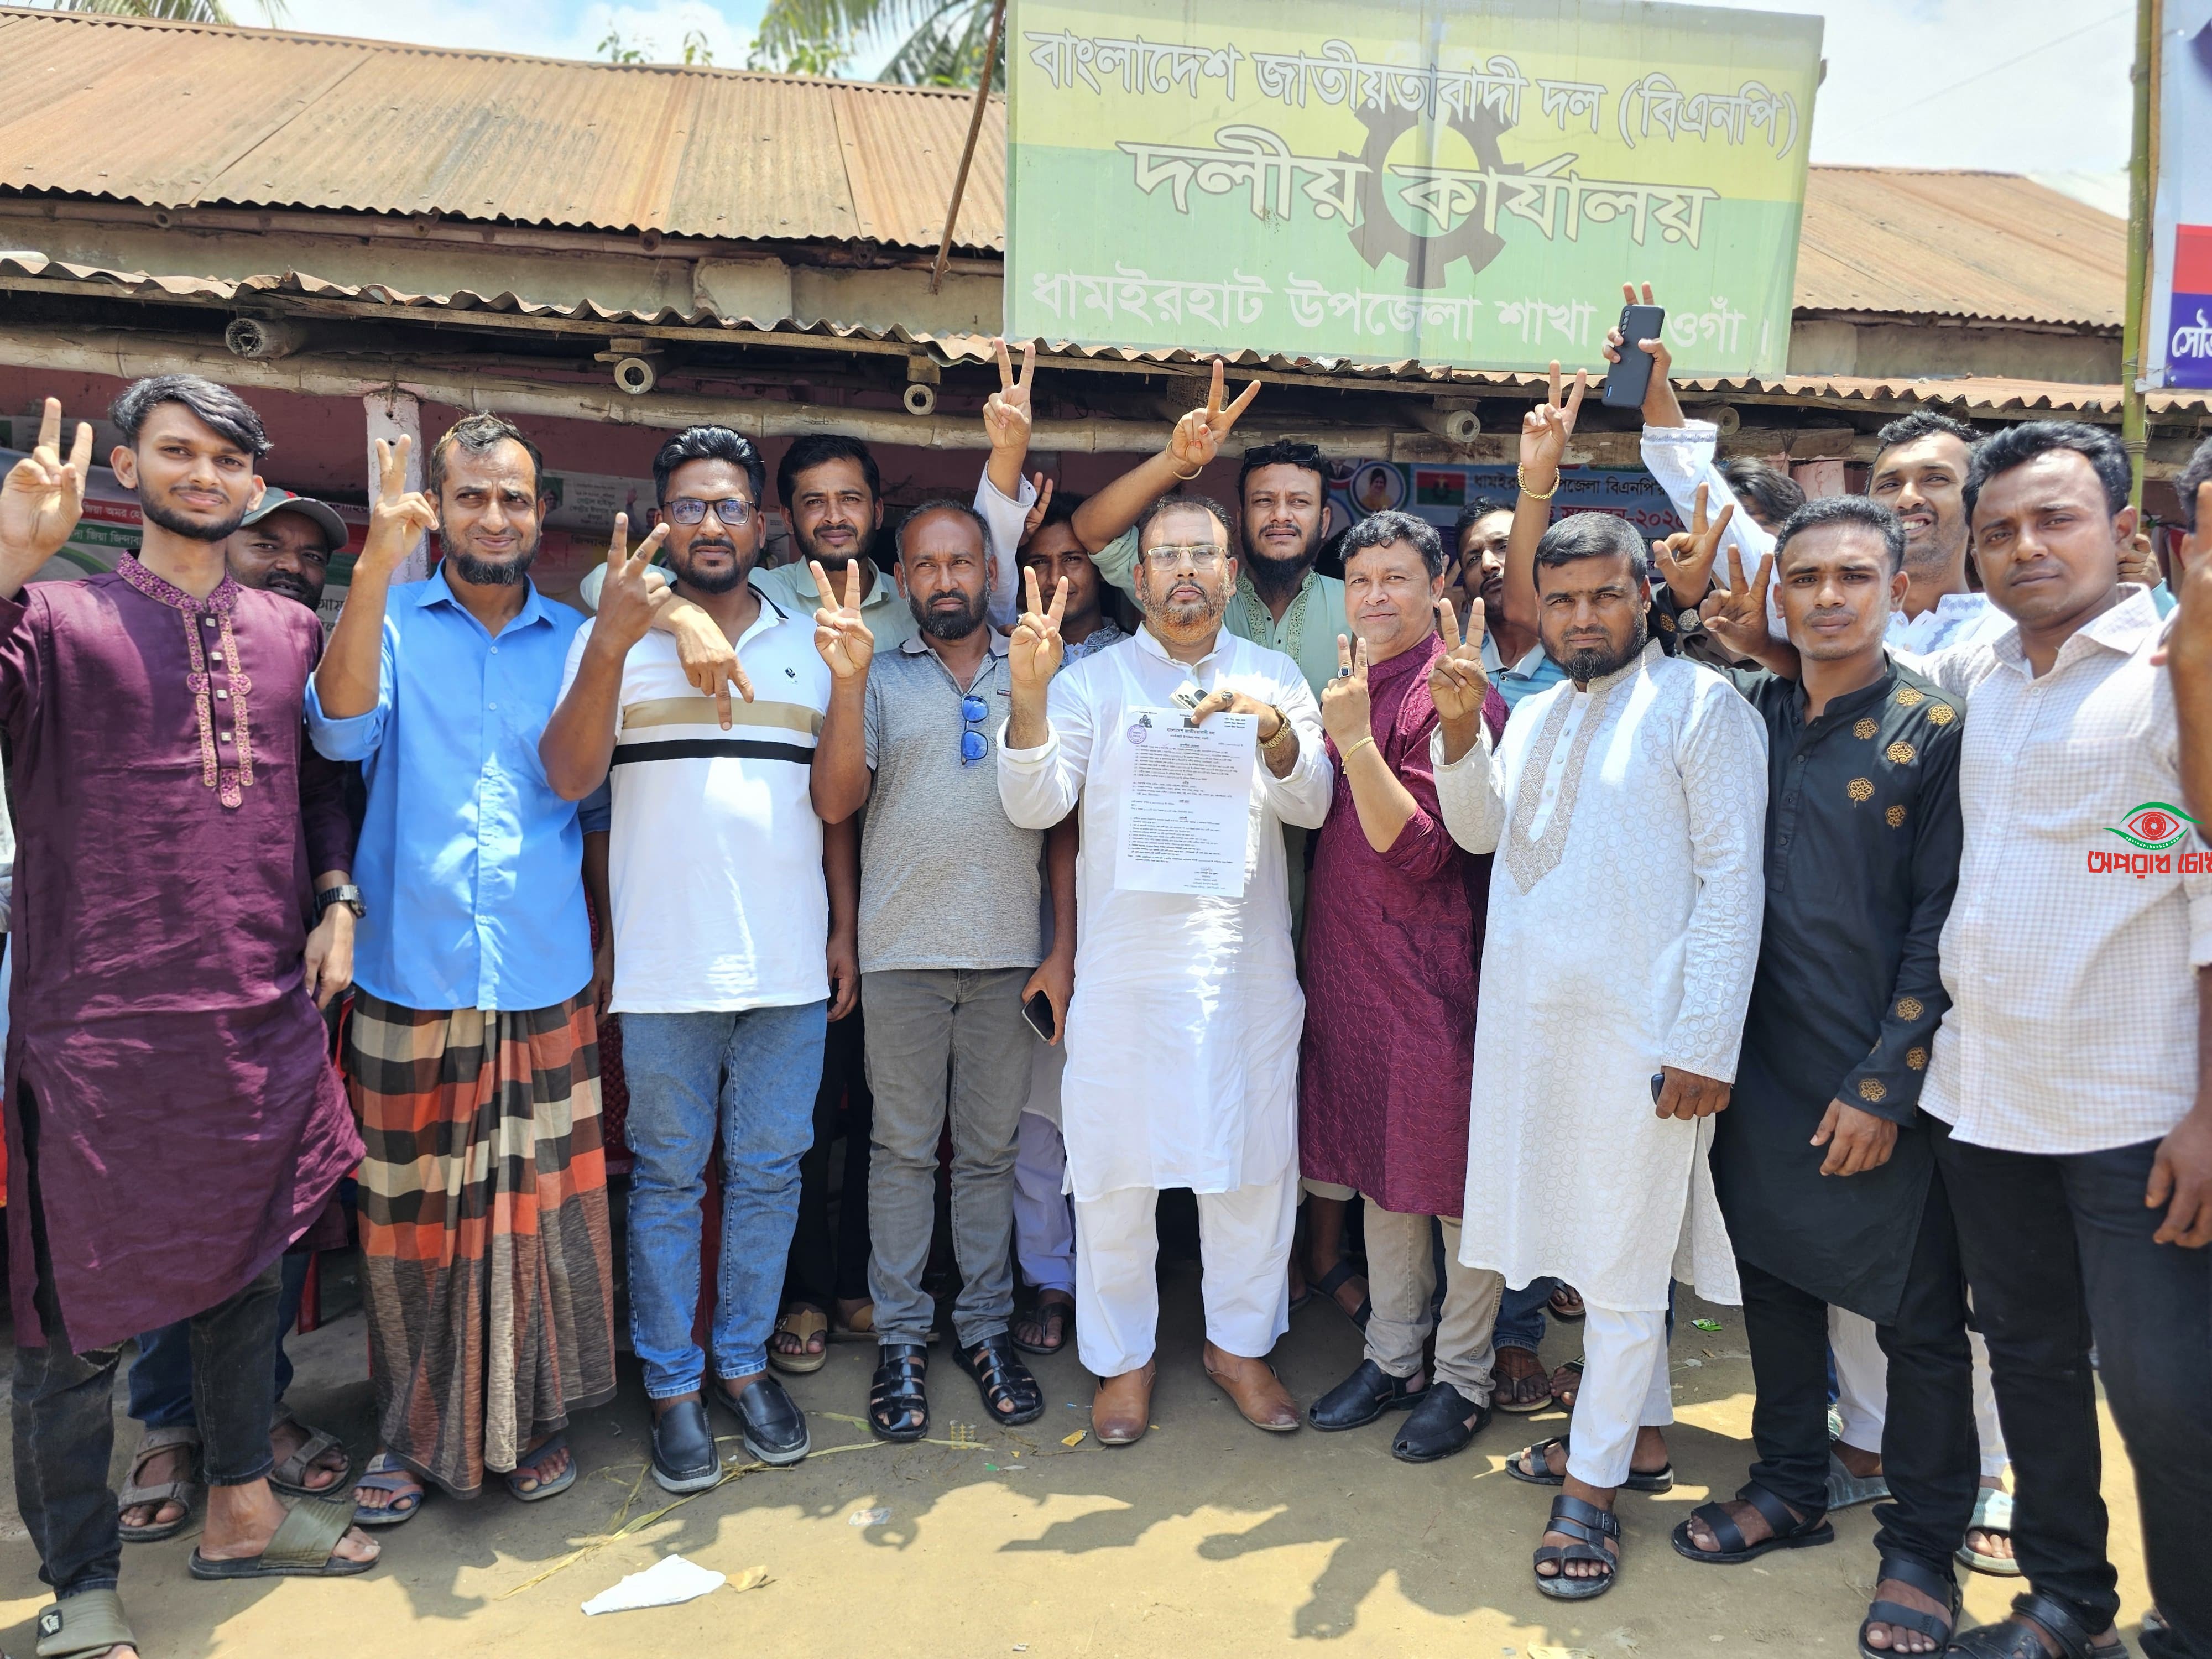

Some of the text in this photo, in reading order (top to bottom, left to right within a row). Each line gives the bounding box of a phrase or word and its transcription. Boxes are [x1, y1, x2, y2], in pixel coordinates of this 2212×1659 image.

[1024, 28, 1798, 160] বাংলাদেশ জাতীয়তাবাদী দল (বিএনপি)
[1114, 124, 1721, 249] দলীয় কার্যালয়
[1031, 260, 1273, 331] ধামইরহাট
[1283, 271, 1484, 342] উপজেলা
[1494, 298, 1598, 347] শাখা
[1474, 471, 1518, 491] ধামইর
[1559, 477, 1601, 494] পজেলা
[110, 530, 142, 546] জিন্দাবা
